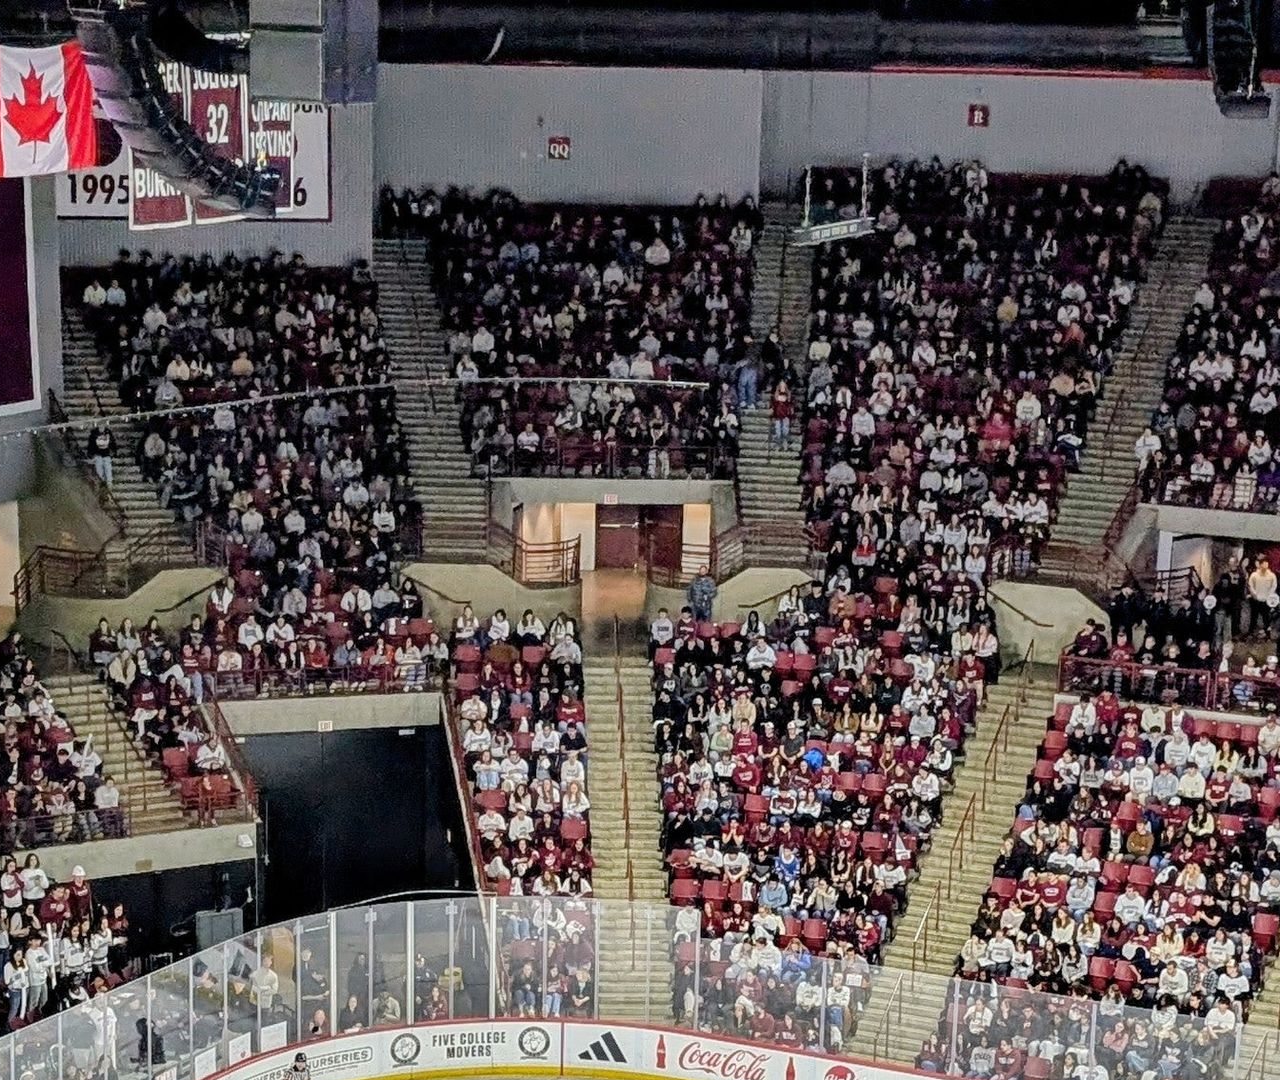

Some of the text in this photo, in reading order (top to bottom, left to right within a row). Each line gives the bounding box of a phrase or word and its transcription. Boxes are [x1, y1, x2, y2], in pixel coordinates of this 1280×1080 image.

[206, 103, 229, 144] 32
[550, 143, 569, 159] QQ
[68, 174, 129, 205] 1995
[432, 1031, 507, 1048] FIVE COLLEGE
[446, 1044, 492, 1060] MOVERS
